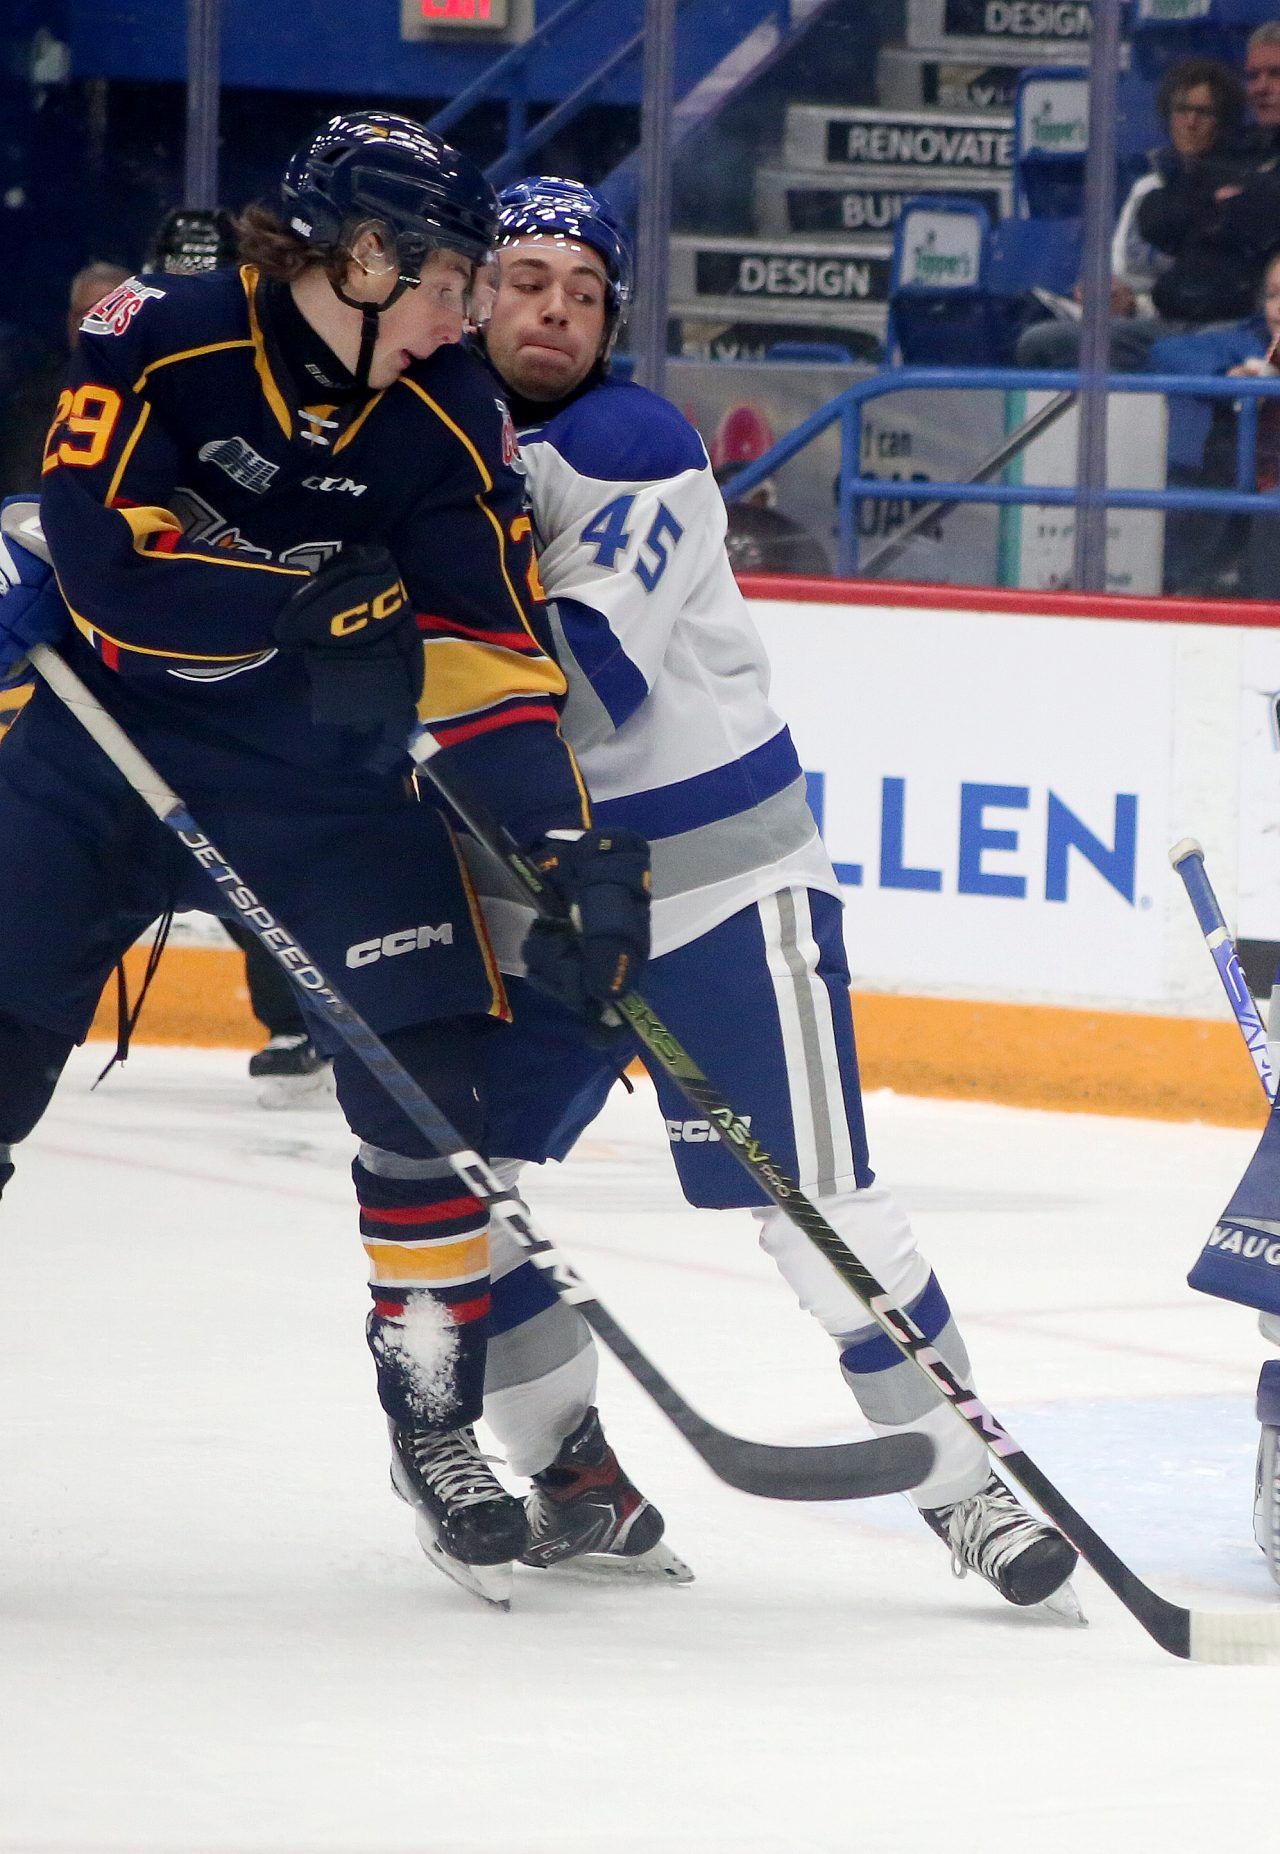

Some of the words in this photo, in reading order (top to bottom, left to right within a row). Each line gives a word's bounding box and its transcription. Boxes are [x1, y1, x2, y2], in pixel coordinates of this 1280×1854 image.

[847, 127, 1013, 164] RENOVATE
[739, 258, 870, 296] DESIGN
[301, 476, 367, 496] CCM
[579, 494, 686, 594] 45
[330, 577, 409, 637] CC
[177, 829, 326, 991] JETSPEED
[344, 922, 453, 970] CCM
[869, 1293, 1024, 1458] CCM
